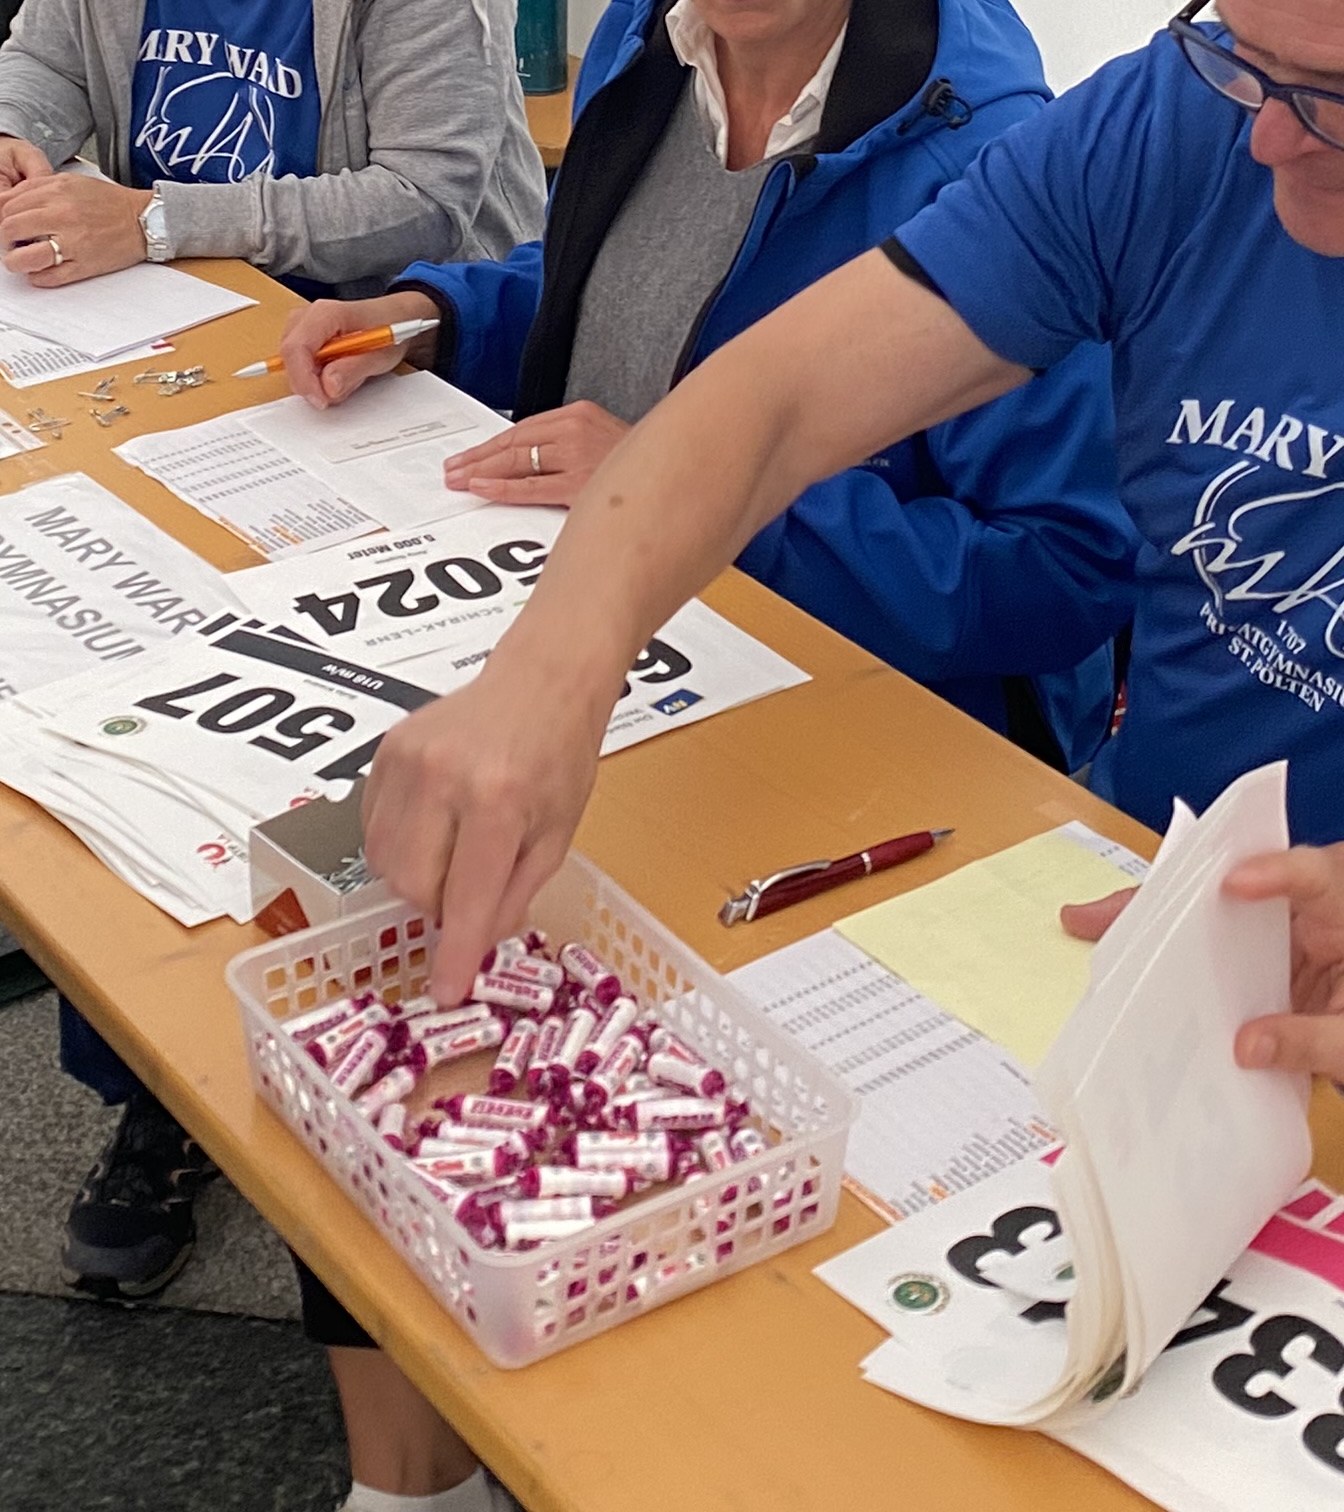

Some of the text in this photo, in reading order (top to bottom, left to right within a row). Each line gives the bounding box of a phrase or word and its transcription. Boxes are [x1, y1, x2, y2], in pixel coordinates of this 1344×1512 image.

[24, 504, 208, 635] MARY WAR
[293, 539, 549, 637] 5024
[1274, 619, 1307, 655] 1707
